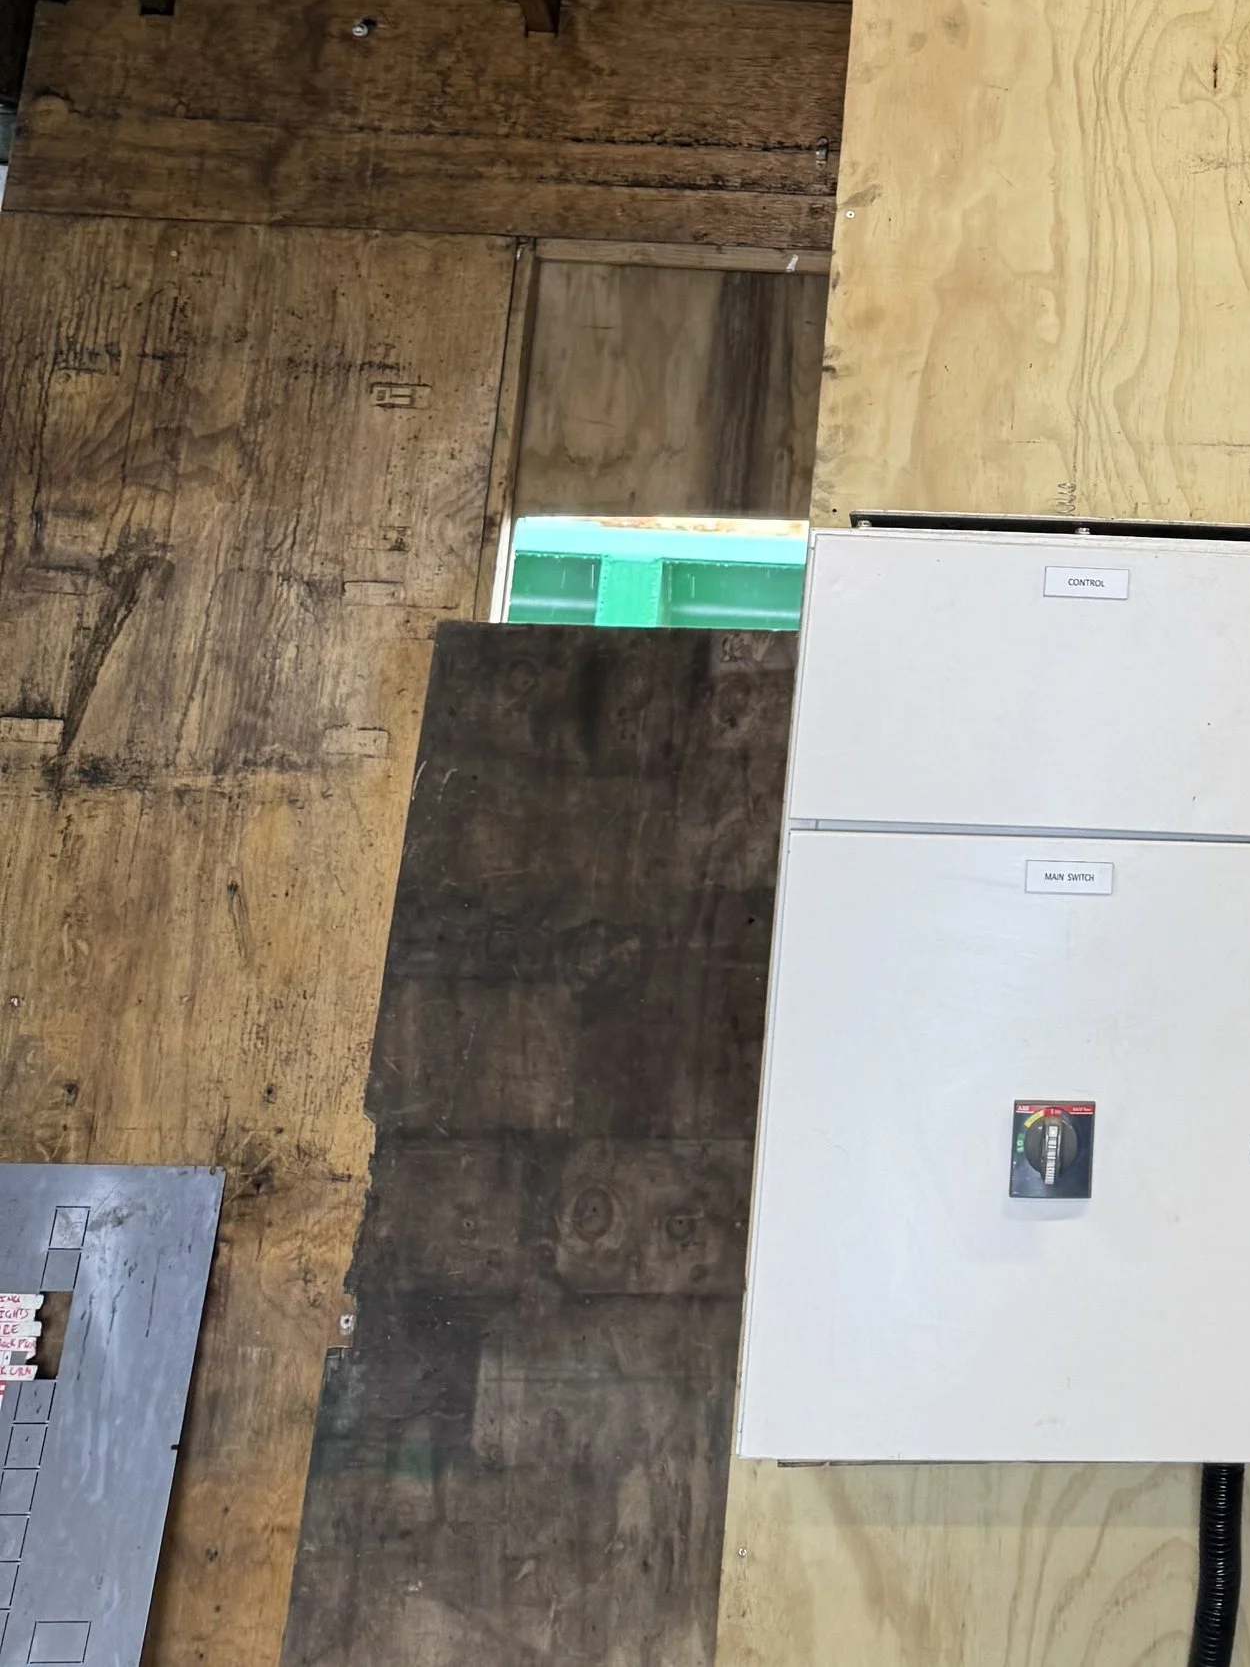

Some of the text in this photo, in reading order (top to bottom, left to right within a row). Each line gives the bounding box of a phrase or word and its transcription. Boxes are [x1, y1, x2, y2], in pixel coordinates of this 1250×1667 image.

[1067, 578, 1105, 588] CONTROL
[1044, 872, 1095, 882] MAIN SWITCH
[0, 1309, 29, 1320] IGHTS
